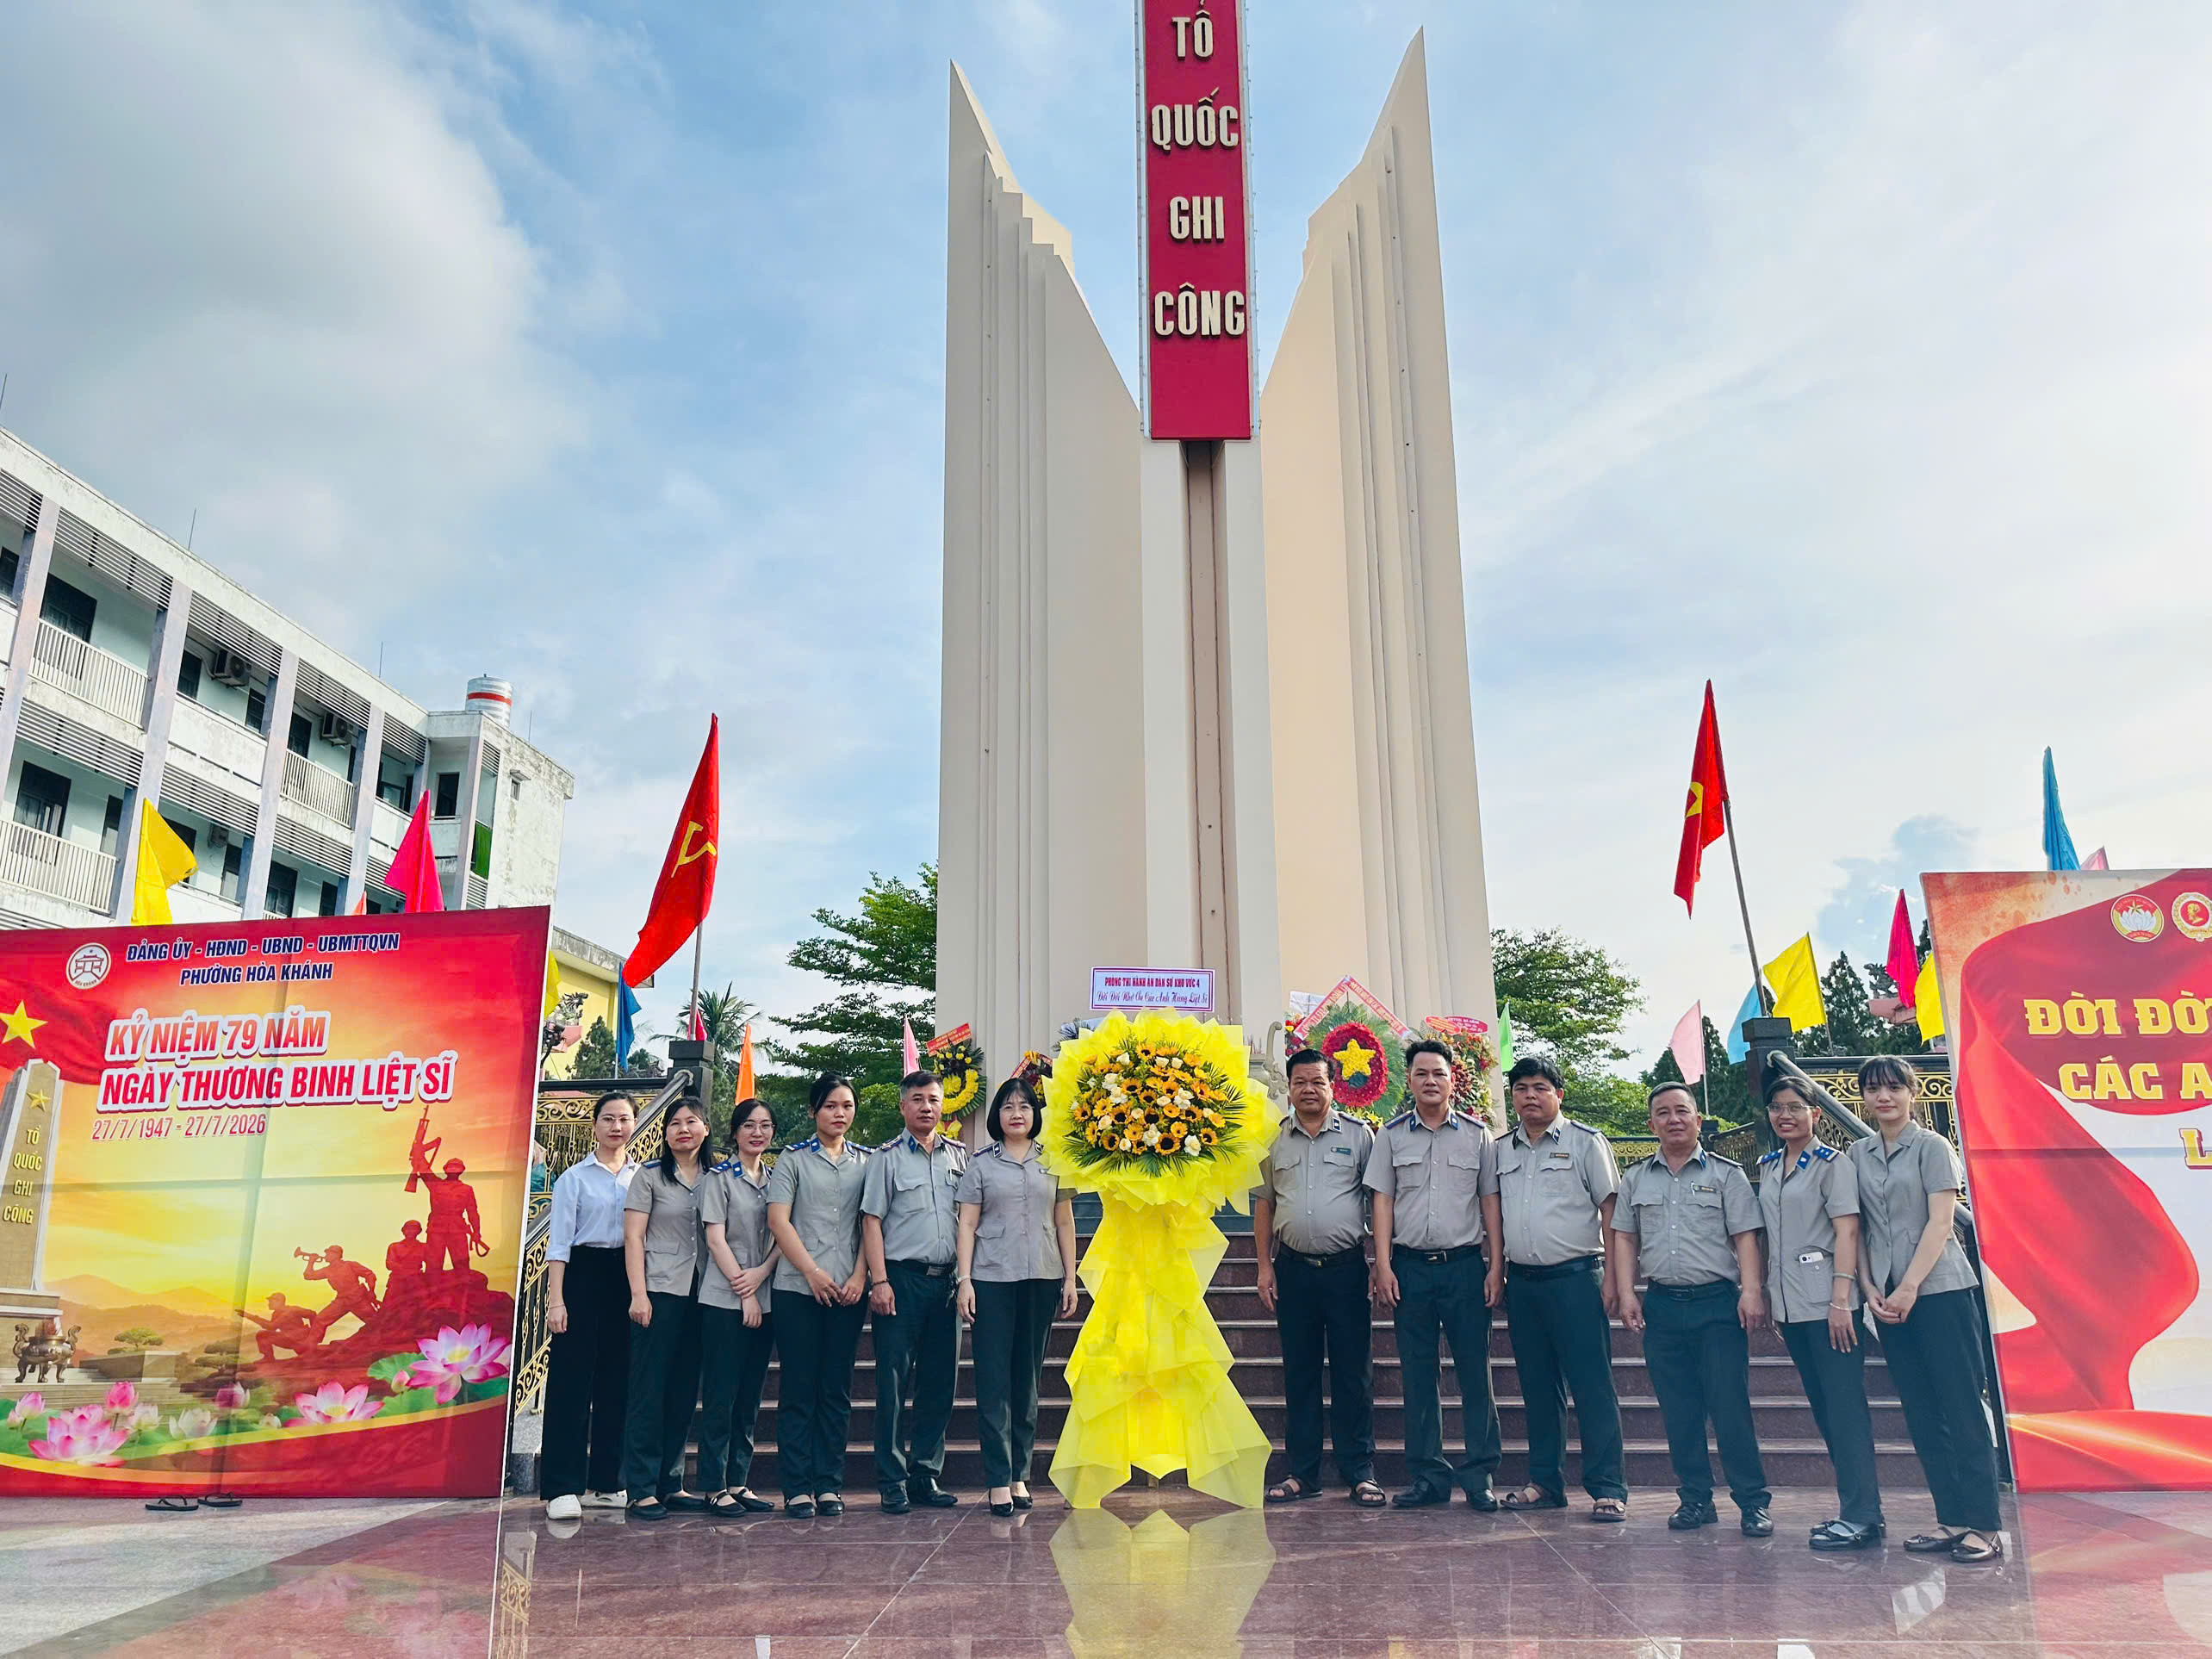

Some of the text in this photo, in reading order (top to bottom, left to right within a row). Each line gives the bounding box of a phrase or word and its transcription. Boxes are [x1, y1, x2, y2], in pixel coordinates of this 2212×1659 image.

[1152, 86, 1239, 150] QUỐC
[1169, 196, 1224, 240] GHI
[1153, 282, 1245, 336] CÔNG
[127, 939, 169, 960] ĐẢNG
[172, 937, 192, 959] ỦY
[206, 940, 247, 957] HĐND
[263, 937, 303, 954] UBND
[319, 934, 400, 952] UBMTTQVN
[180, 960, 333, 985] PHƯỜNG HÒA KHÁNH
[1122, 977, 1131, 987] THI
[1174, 978, 1184, 988] KHU
[1196, 979, 1200, 988] 4
[1155, 991, 1170, 1002] Anh
[2023, 991, 2212, 1035] ĐỜI ĐỜ
[109, 1010, 326, 1059] KỶ NIỆM 79 NĂM
[102, 1056, 453, 1105] NGÀY THƯƠNG BINH LIỆT SĨ
[2059, 1055, 2164, 1100] CÁC
[91, 1117, 173, 1140] 27/7/1947
[184, 1114, 267, 1137] 27/7/2026
[13, 1151, 43, 1171] QUỐC
[13, 1179, 33, 1196] GHI
[3, 1204, 34, 1224] CÔNG
